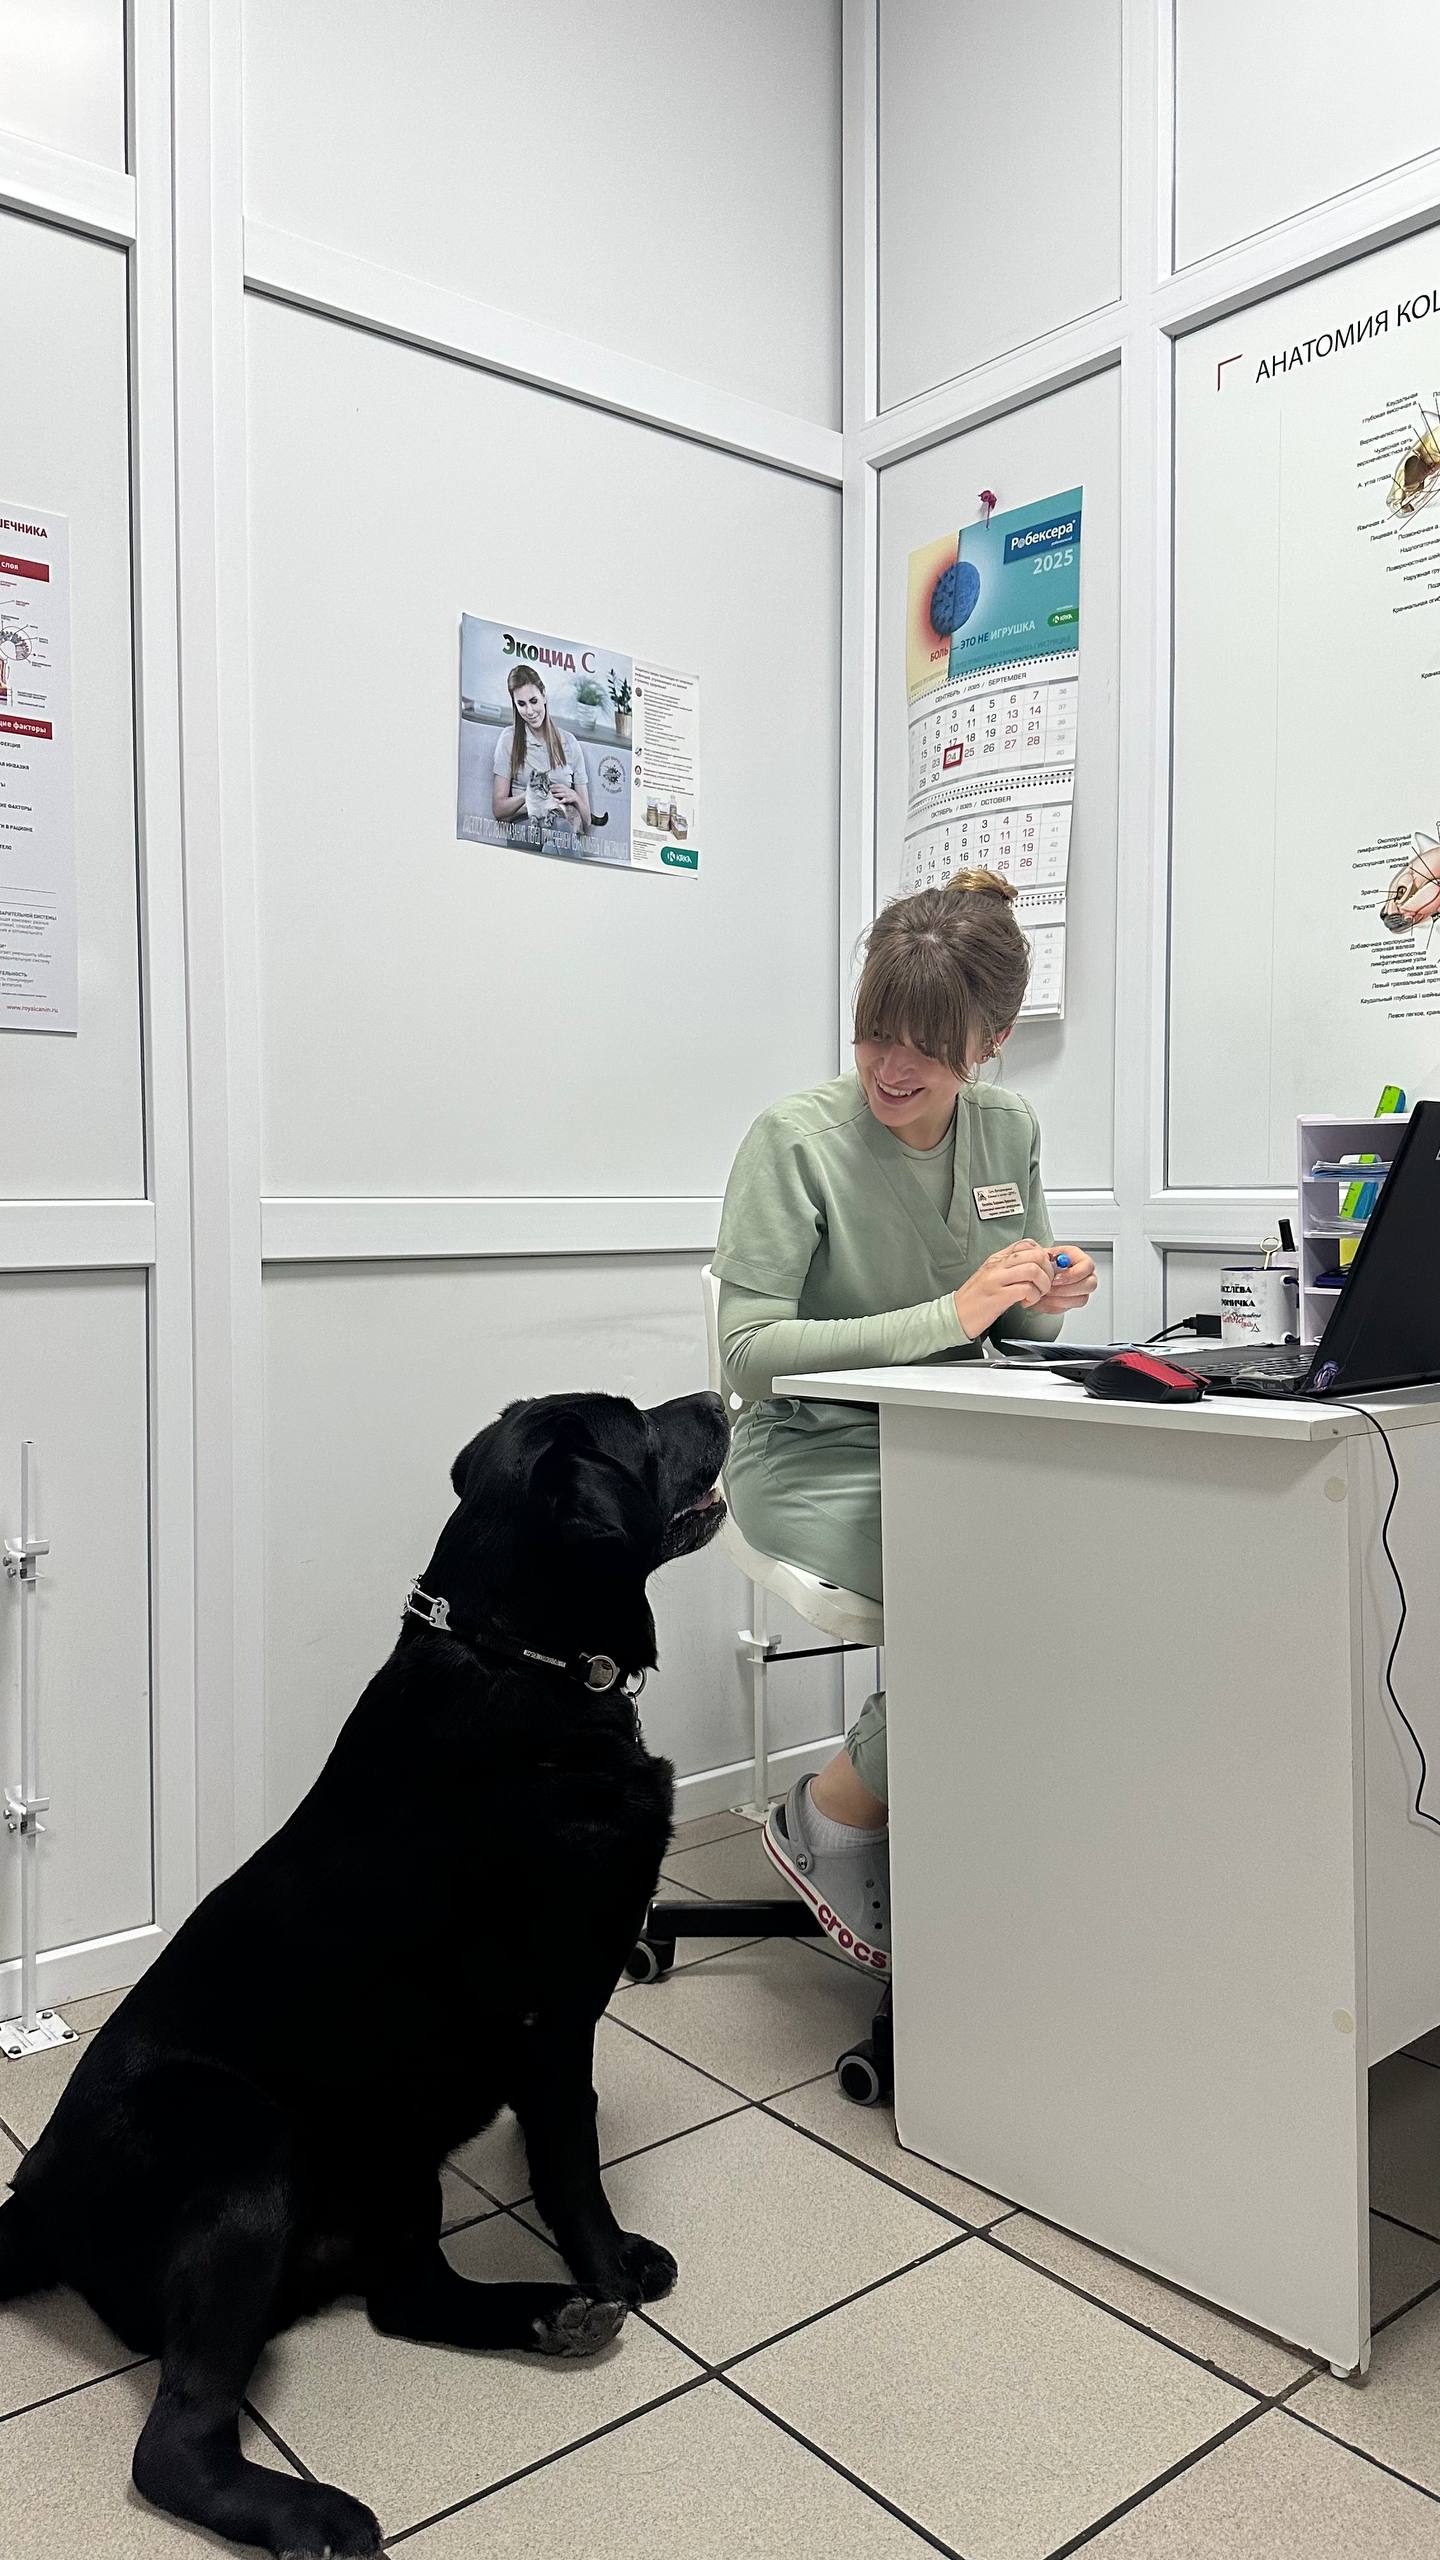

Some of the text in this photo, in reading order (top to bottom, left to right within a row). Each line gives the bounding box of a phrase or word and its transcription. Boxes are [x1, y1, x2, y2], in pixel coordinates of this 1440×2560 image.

[1255, 310, 1388, 384] АНАТОМИЯ
[1011, 520, 1075, 551] Робексера
[1033, 549, 1074, 575] 2025
[502, 634, 576, 673] Экоцид
[930, 620, 1036, 662] БОЛЬ ЭТО НЕ ИГРУШКА
[988, 672, 1027, 687] SEPTEMBER
[936, 716, 941, 724] 2
[952, 710, 957, 718] 3
[969, 704, 975, 712] 4
[988, 699, 995, 709] 5
[1010, 695, 1017, 704] 6
[1033, 691, 1039, 700] 7
[950, 723, 959, 733] 10
[967, 718, 976, 728] 11
[986, 714, 996, 723] 12
[1007, 709, 1018, 719] 13
[1029, 705, 1041, 715] 14
[13, 721, 47, 733] факторы
[934, 744, 941, 753] 16
[966, 733, 976, 742] 18
[986, 728, 996, 738] 19
[1005, 724, 1018, 734] 20
[1028, 721, 1040, 731] 21
[965, 747, 975, 758] 25
[984, 743, 995, 753] 26
[1005, 739, 1017, 749] 27
[1027, 736, 1040, 746] 28
[980, 796, 1011, 806] OCTOBER
[962, 823, 967, 832] 2
[982, 820, 988, 828] 3
[1003, 816, 1009, 824] 4
[1026, 813, 1033, 822] 5
[944, 842, 949, 851] 8
[962, 838, 967, 847] 9
[980, 834, 990, 843] 10
[1000, 831, 1011, 840] 11
[1023, 828, 1035, 837] 12
[928, 860, 935, 869] 14
[943, 856, 951, 865] 15
[960, 852, 969, 861] 16
[979, 849, 989, 858] 17
[1000, 845, 1011, 855] 18
[1022, 843, 1033, 852] 19
[927, 874, 934, 884] 21
[941, 871, 950, 880] 22
[997, 860, 1009, 870] 25
[1020, 858, 1033, 868] 26
[817, 1904, 887, 1969] crocs
